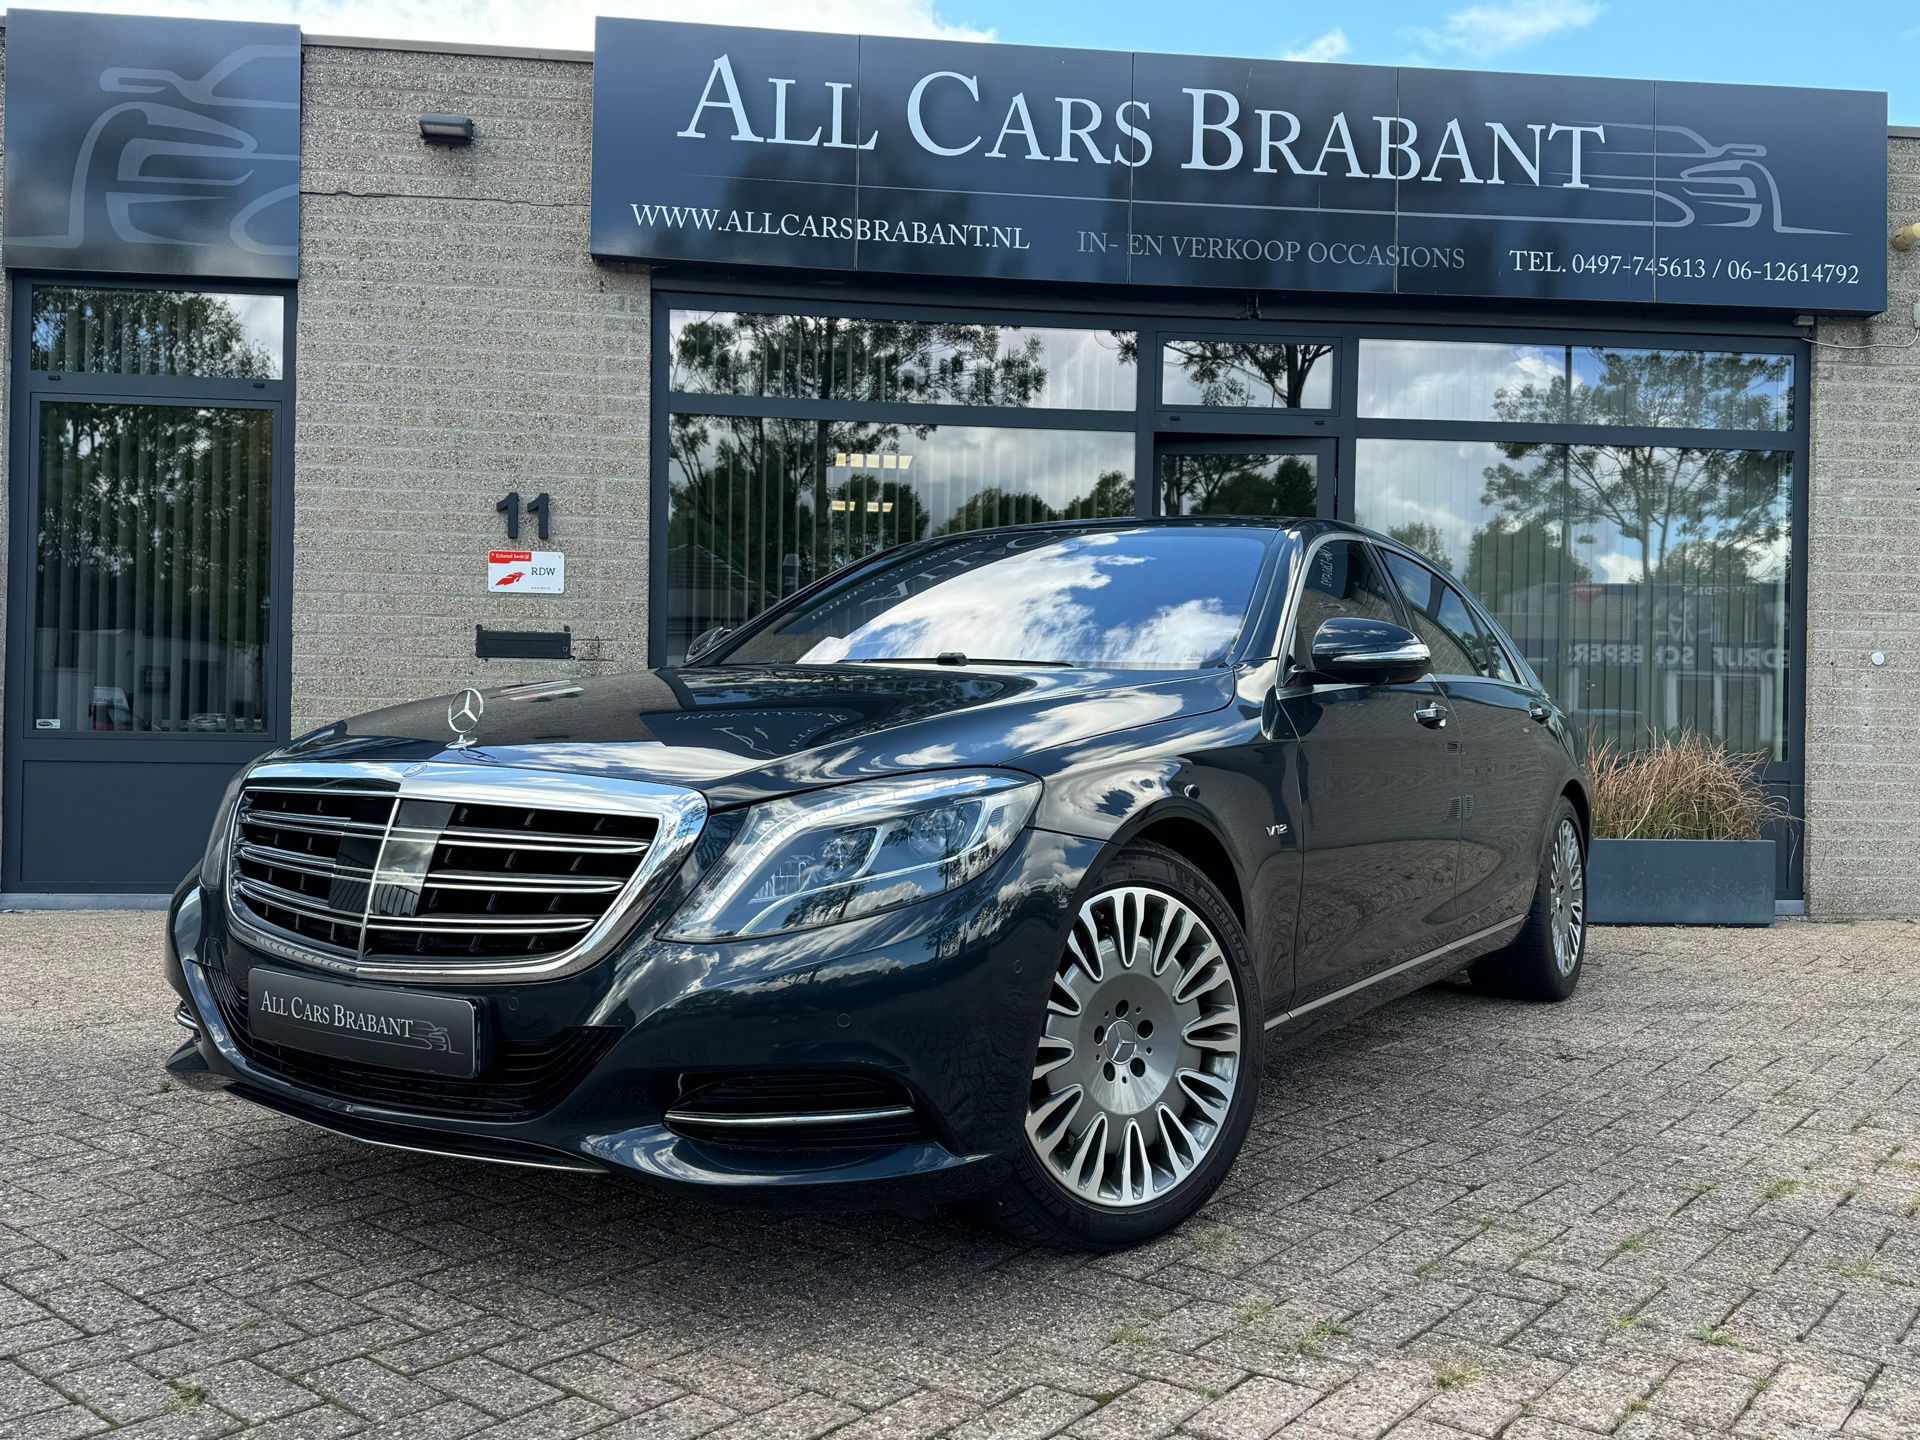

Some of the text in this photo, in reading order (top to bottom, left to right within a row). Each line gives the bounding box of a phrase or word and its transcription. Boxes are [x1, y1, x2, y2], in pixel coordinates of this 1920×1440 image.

[630, 203, 1031, 249] WWW.ALLCARSBRABANT.NL
[1077, 230, 1465, 269] IN- EN VERKOOP OCCASIONS
[1509, 250, 1860, 284] TEL. 0497-745613 / 06-12614792
[496, 492, 549, 540] 11
[531, 567, 556, 576] RDW
[1265, 823, 1288, 837] V12
